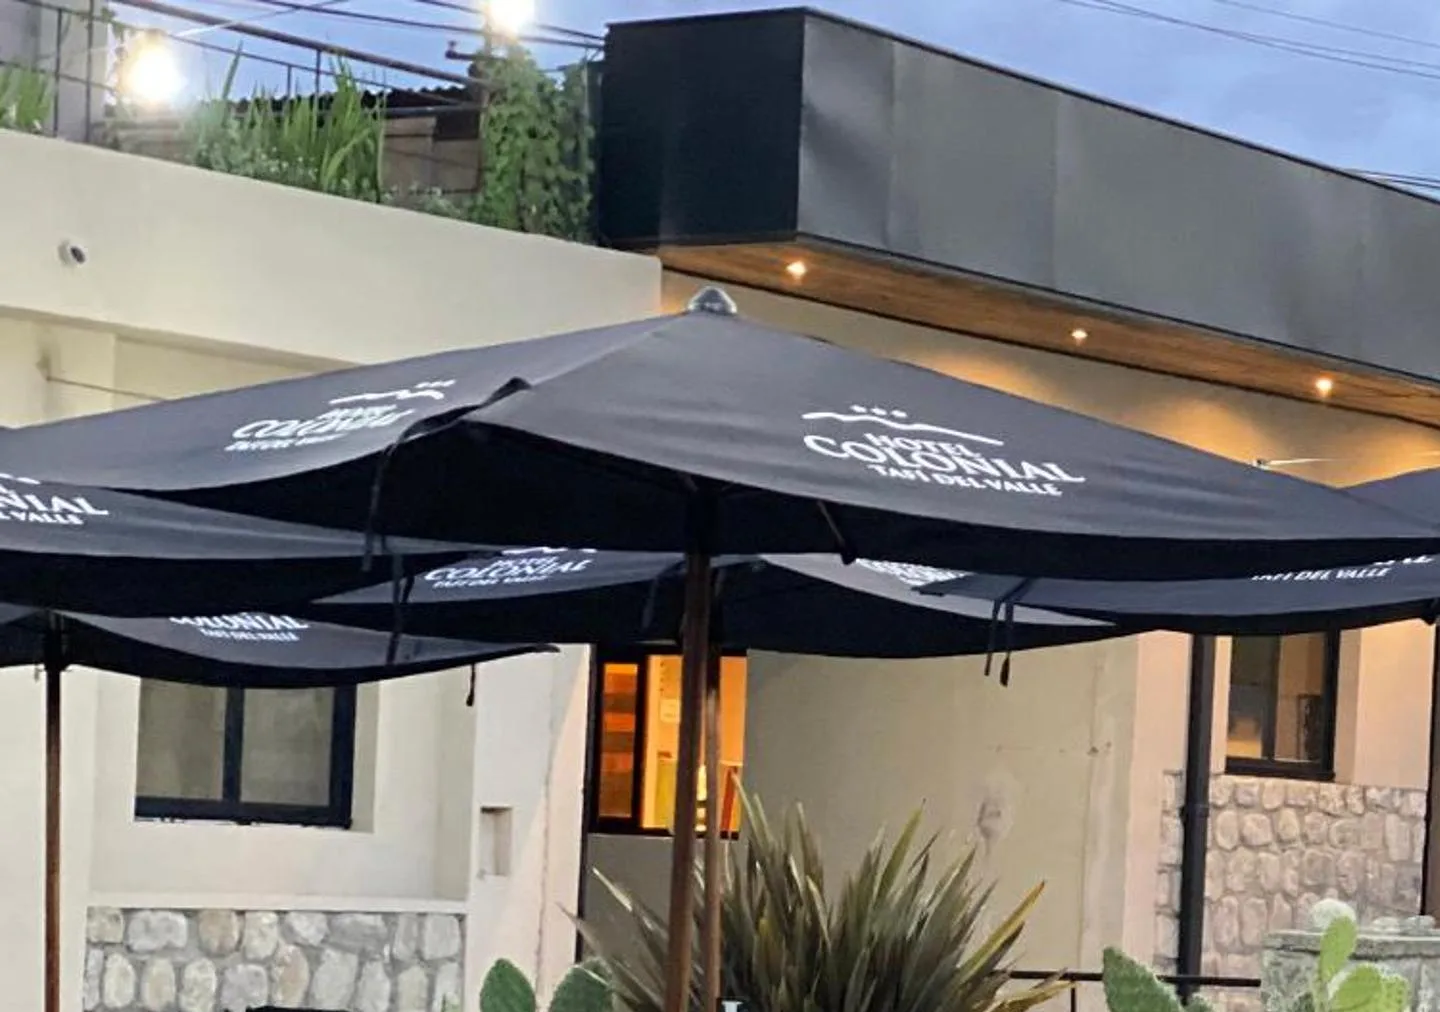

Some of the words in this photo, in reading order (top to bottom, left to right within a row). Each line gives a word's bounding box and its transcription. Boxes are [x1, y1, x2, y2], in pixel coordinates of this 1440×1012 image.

[864, 432, 982, 457] HOTEL
[804, 435, 1085, 482] COLONIAL
[0, 485, 109, 515] NIAL
[983, 479, 1062, 496] VALLE
